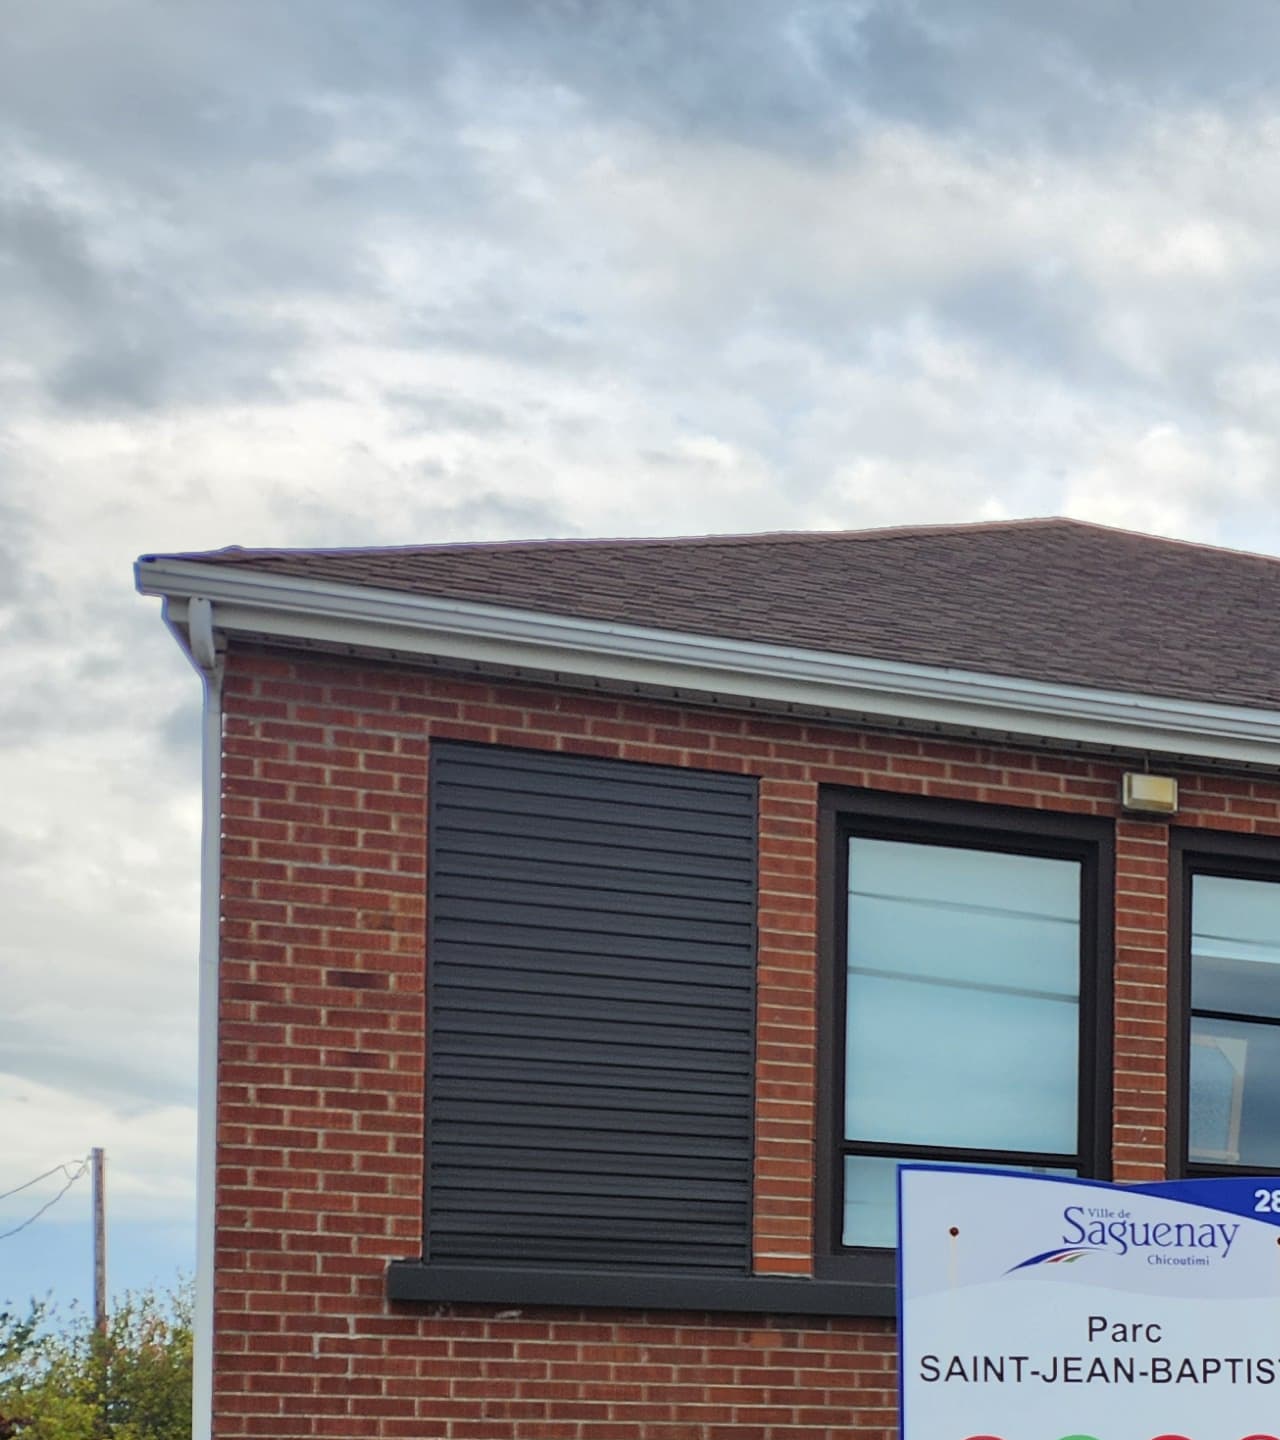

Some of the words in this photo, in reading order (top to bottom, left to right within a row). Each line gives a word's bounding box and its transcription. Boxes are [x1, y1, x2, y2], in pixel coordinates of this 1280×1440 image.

[1088, 1208, 1115, 1218] Ville
[1117, 1209, 1131, 1219] de
[1062, 1206, 1240, 1258] Saguenay
[1147, 1255, 1210, 1266] Chicoutimi
[1087, 1317, 1162, 1343] Parc
